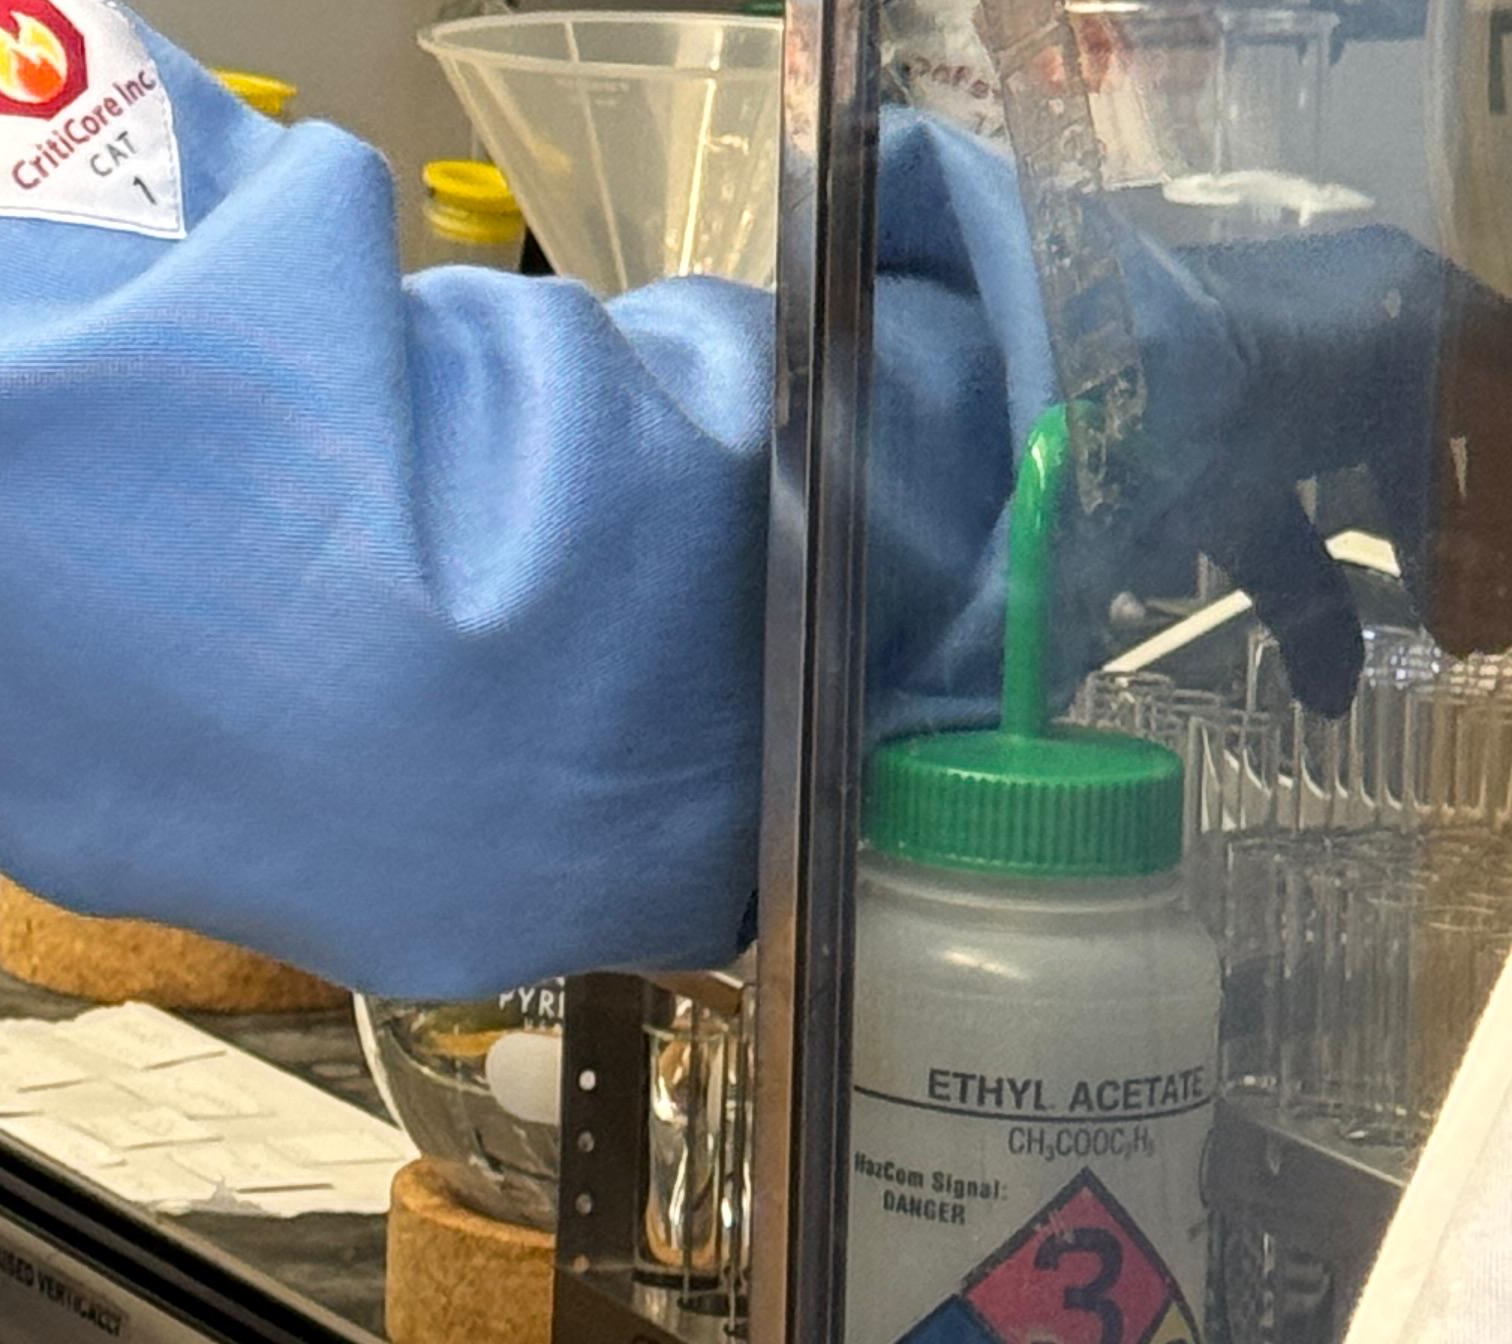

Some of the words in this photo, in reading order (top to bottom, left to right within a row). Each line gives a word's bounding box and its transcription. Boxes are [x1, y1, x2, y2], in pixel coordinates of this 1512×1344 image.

[11, 95, 125, 191] CritiCore
[113, 70, 157, 108] Inc
[89, 130, 139, 178] CAT
[132, 175, 158, 206] 1
[926, 1067, 1056, 1113] ETHYL
[1068, 1065, 1205, 1113] ACETATE
[882, 1190, 967, 1226] DANGER
